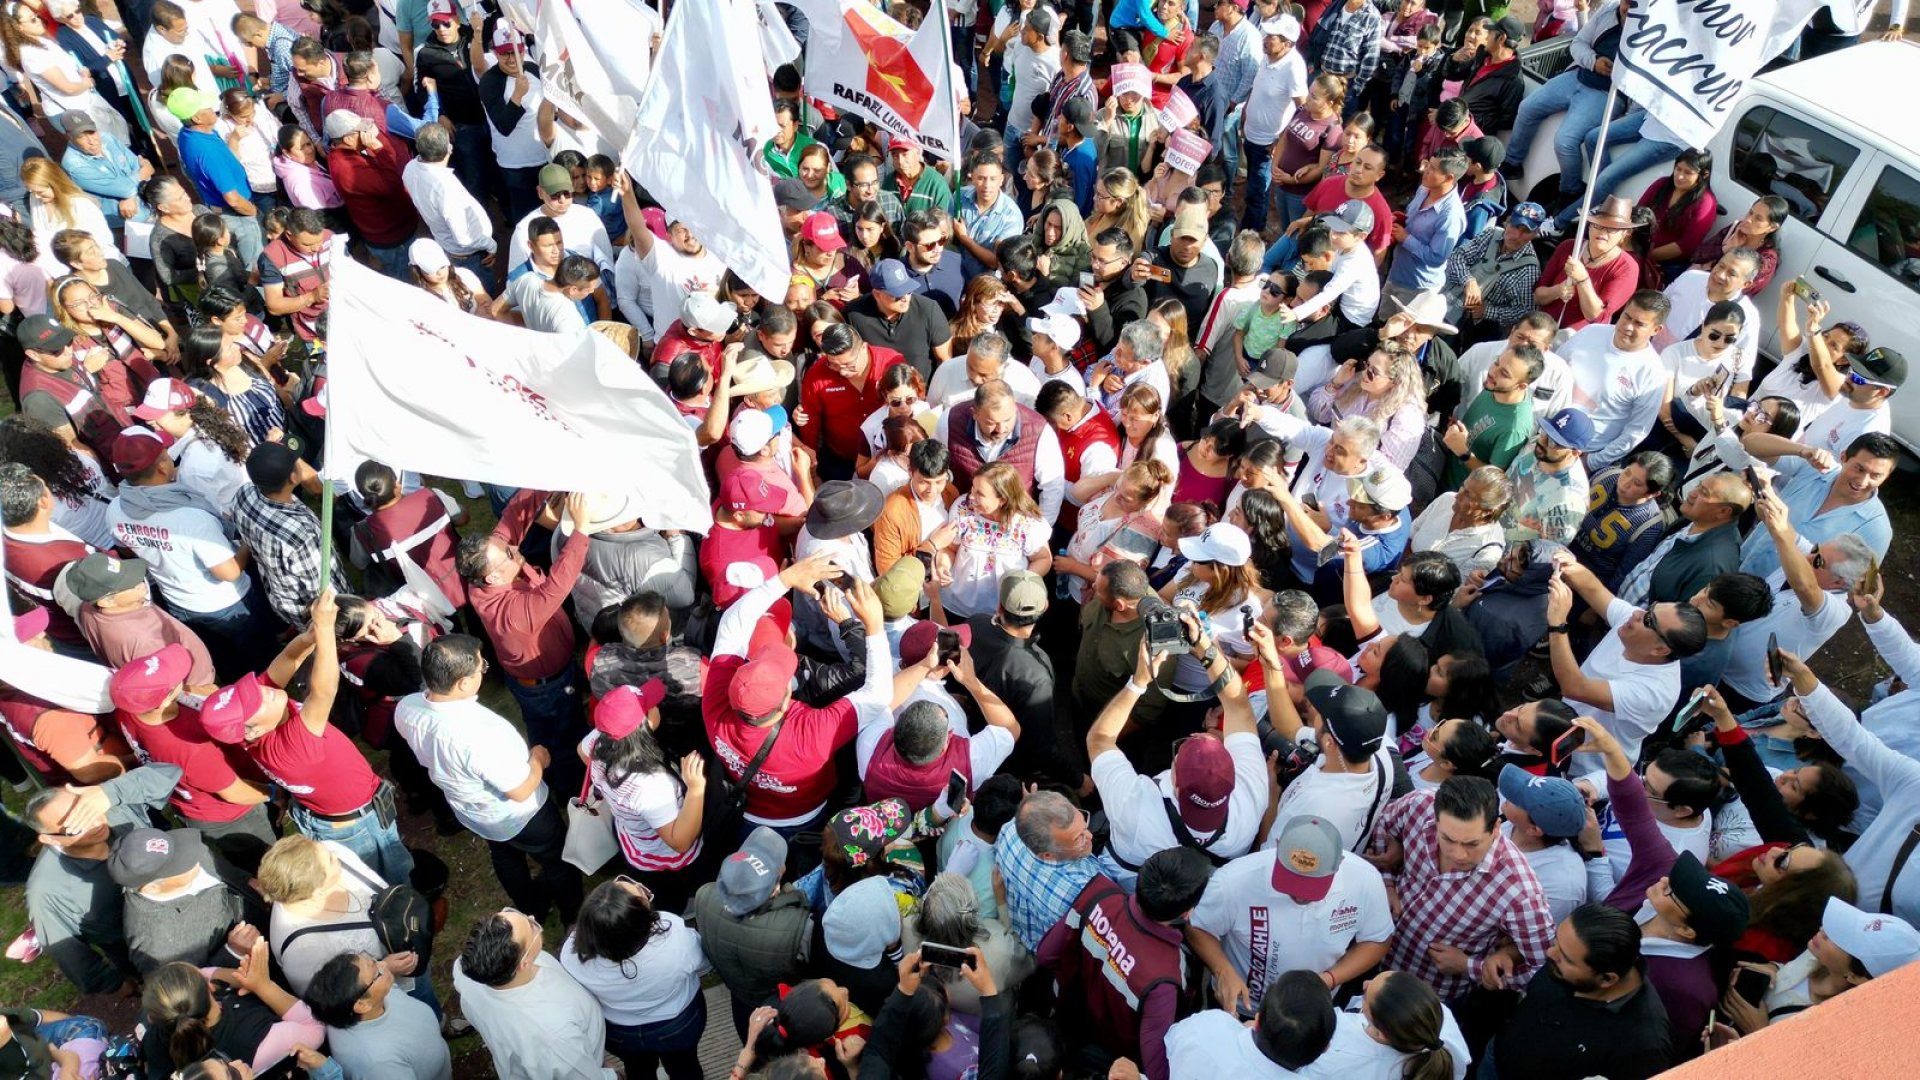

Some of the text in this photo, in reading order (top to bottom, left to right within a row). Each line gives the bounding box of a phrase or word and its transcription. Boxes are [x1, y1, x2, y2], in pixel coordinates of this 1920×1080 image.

[833, 82, 883, 118] RAFAEL
[1167, 151, 1197, 172] moren
[1190, 793, 1228, 808] morena
[743, 854, 770, 877] FOX
[1705, 877, 1729, 895] NY
